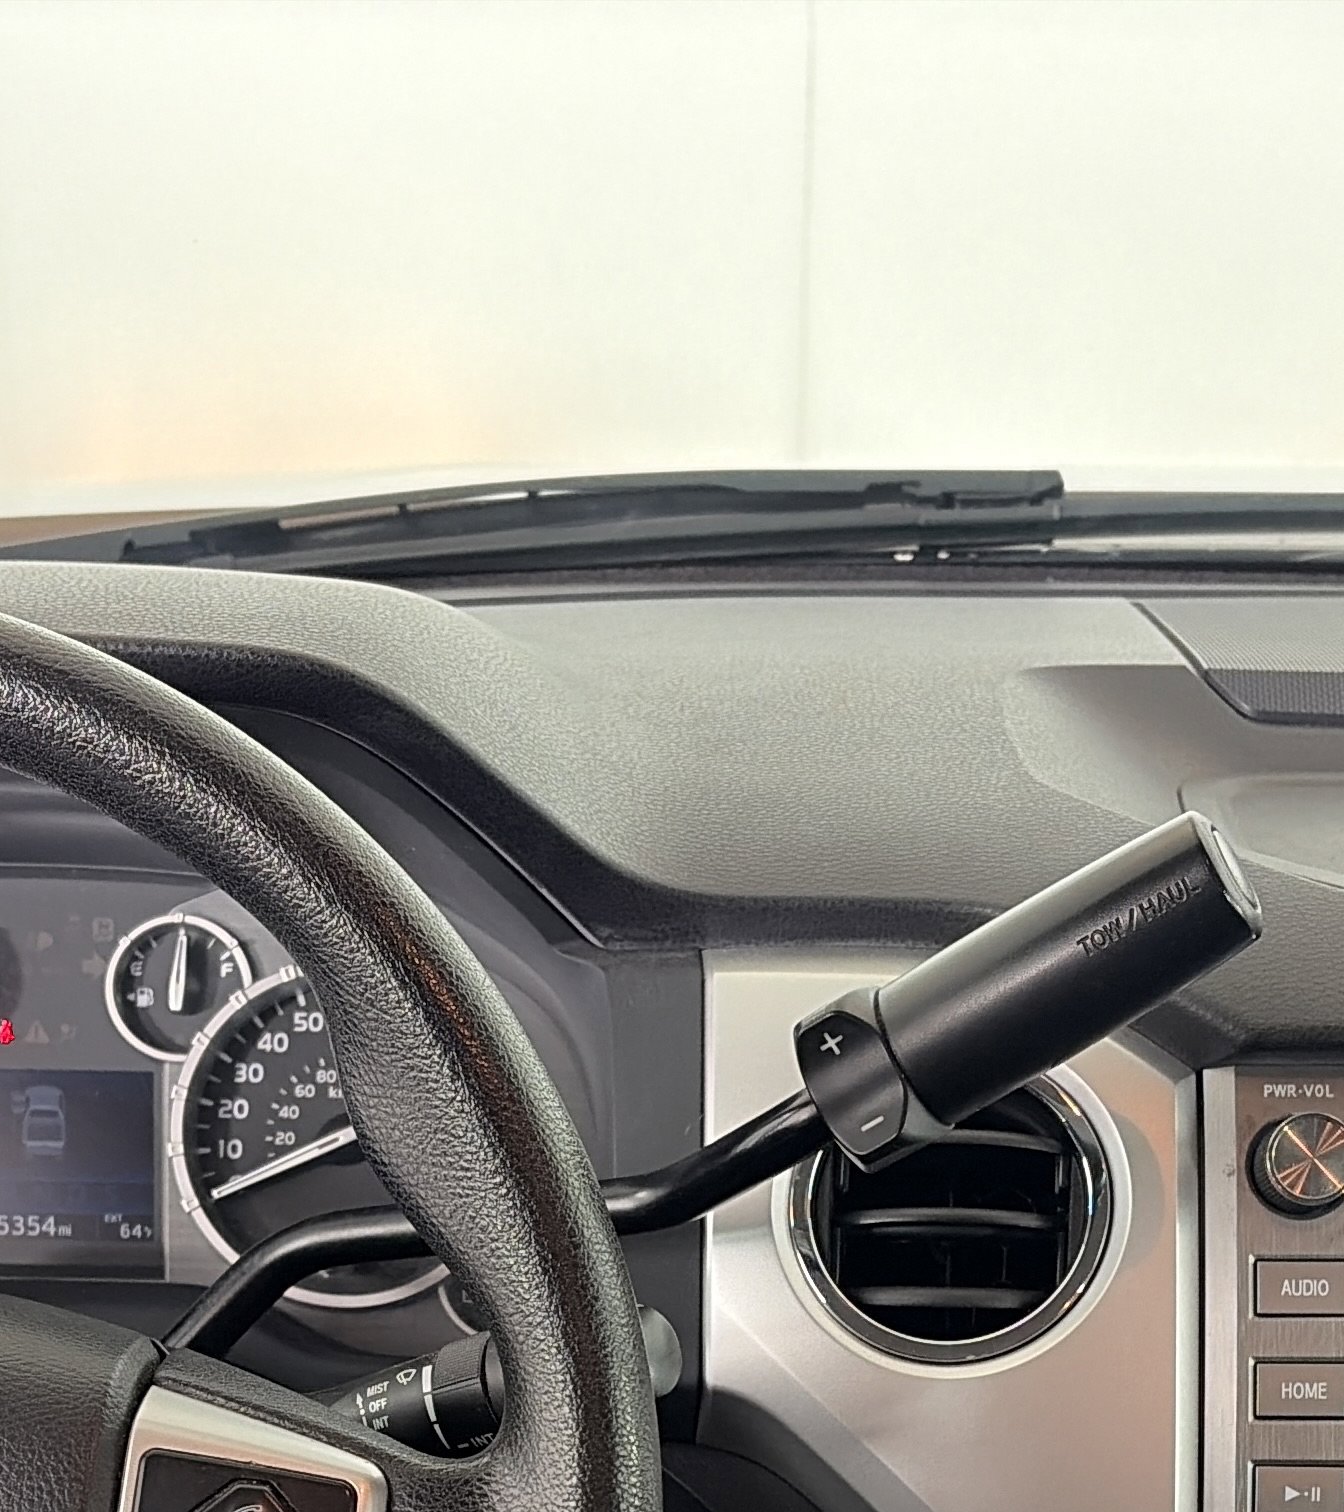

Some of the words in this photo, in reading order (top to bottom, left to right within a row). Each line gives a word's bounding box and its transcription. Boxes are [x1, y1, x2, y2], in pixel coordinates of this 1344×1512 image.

[1076, 876, 1202, 957] TOW/HAUL
[219, 962, 234, 978] F
[293, 1012, 324, 1033] 50
[257, 1031, 290, 1053] 40
[233, 1063, 264, 1084] 30
[316, 1069, 337, 1084] 80
[294, 1084, 316, 1099] 60
[218, 1098, 249, 1119] 20
[278, 1105, 300, 1120] 40
[274, 1131, 296, 1146] 20
[218, 1138, 243, 1160] 10
[1280, 1279, 1330, 1297] AUDIO
[366, 1380, 390, 1398] MIST
[1280, 1382, 1328, 1401] HOME
[368, 1397, 388, 1413] OFF
[372, 1415, 389, 1431] INT
[470, 1432, 494, 1448] INT
